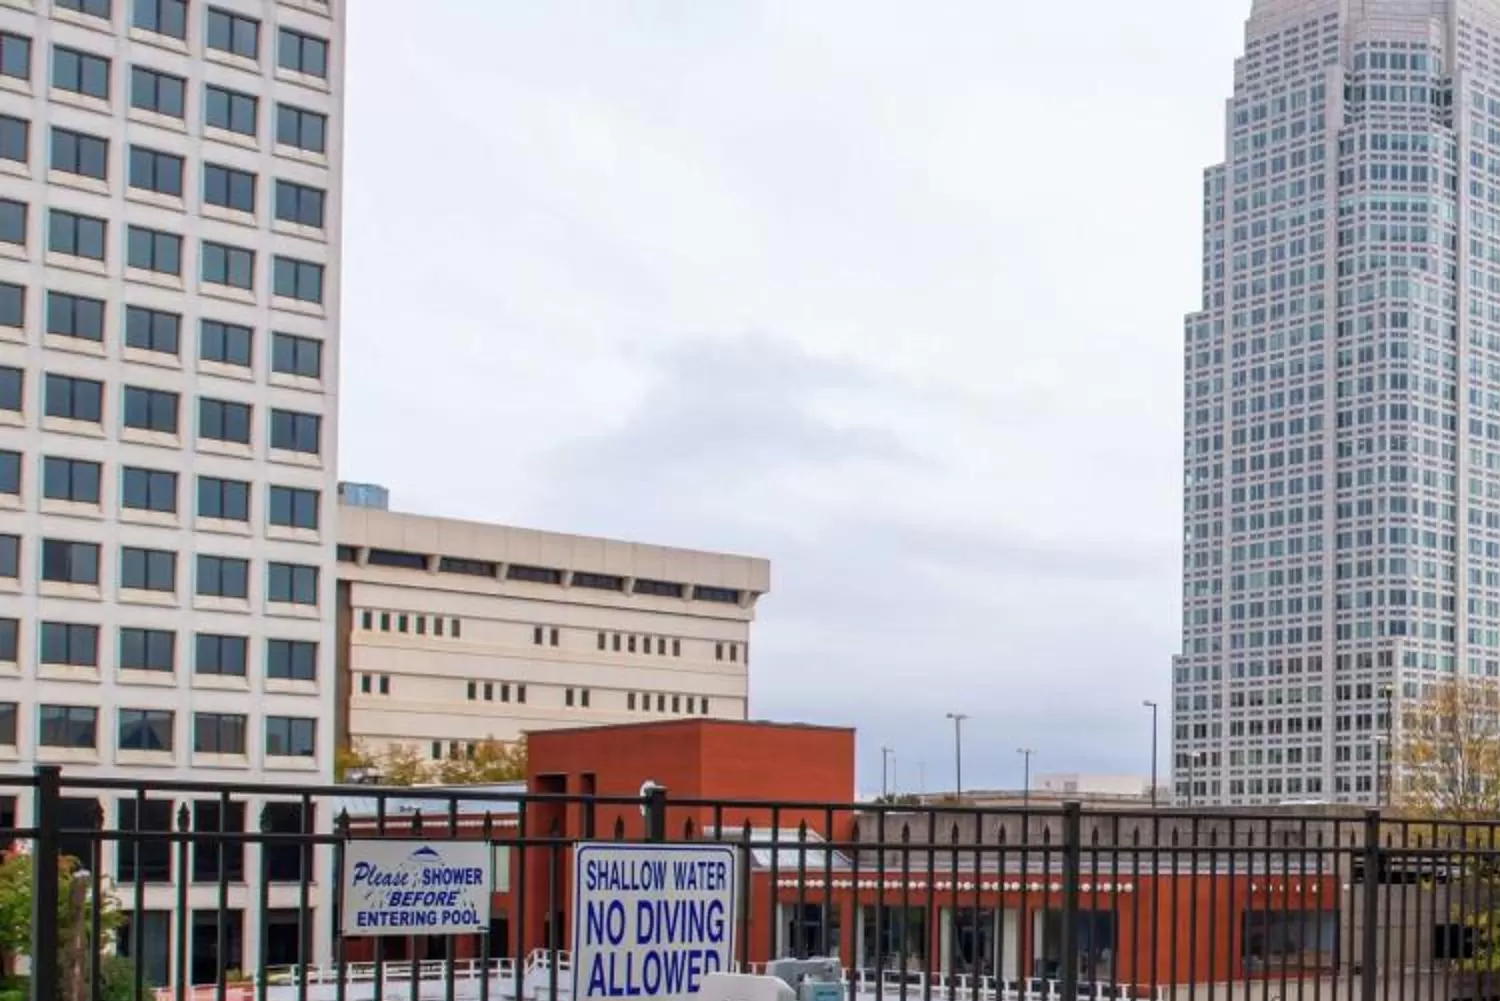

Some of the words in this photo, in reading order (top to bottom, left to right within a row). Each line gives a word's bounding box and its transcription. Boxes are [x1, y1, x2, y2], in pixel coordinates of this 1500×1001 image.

[352, 861, 409, 886] Please
[422, 867, 483, 885] SHOWER
[586, 860, 667, 891] SHALLOW
[673, 861, 727, 891] WATER
[388, 891, 460, 907] BEFORE
[357, 911, 437, 927] ENTERING
[442, 910, 481, 925] POOL
[586, 900, 625, 946] NO
[637, 899, 725, 945] DIVING
